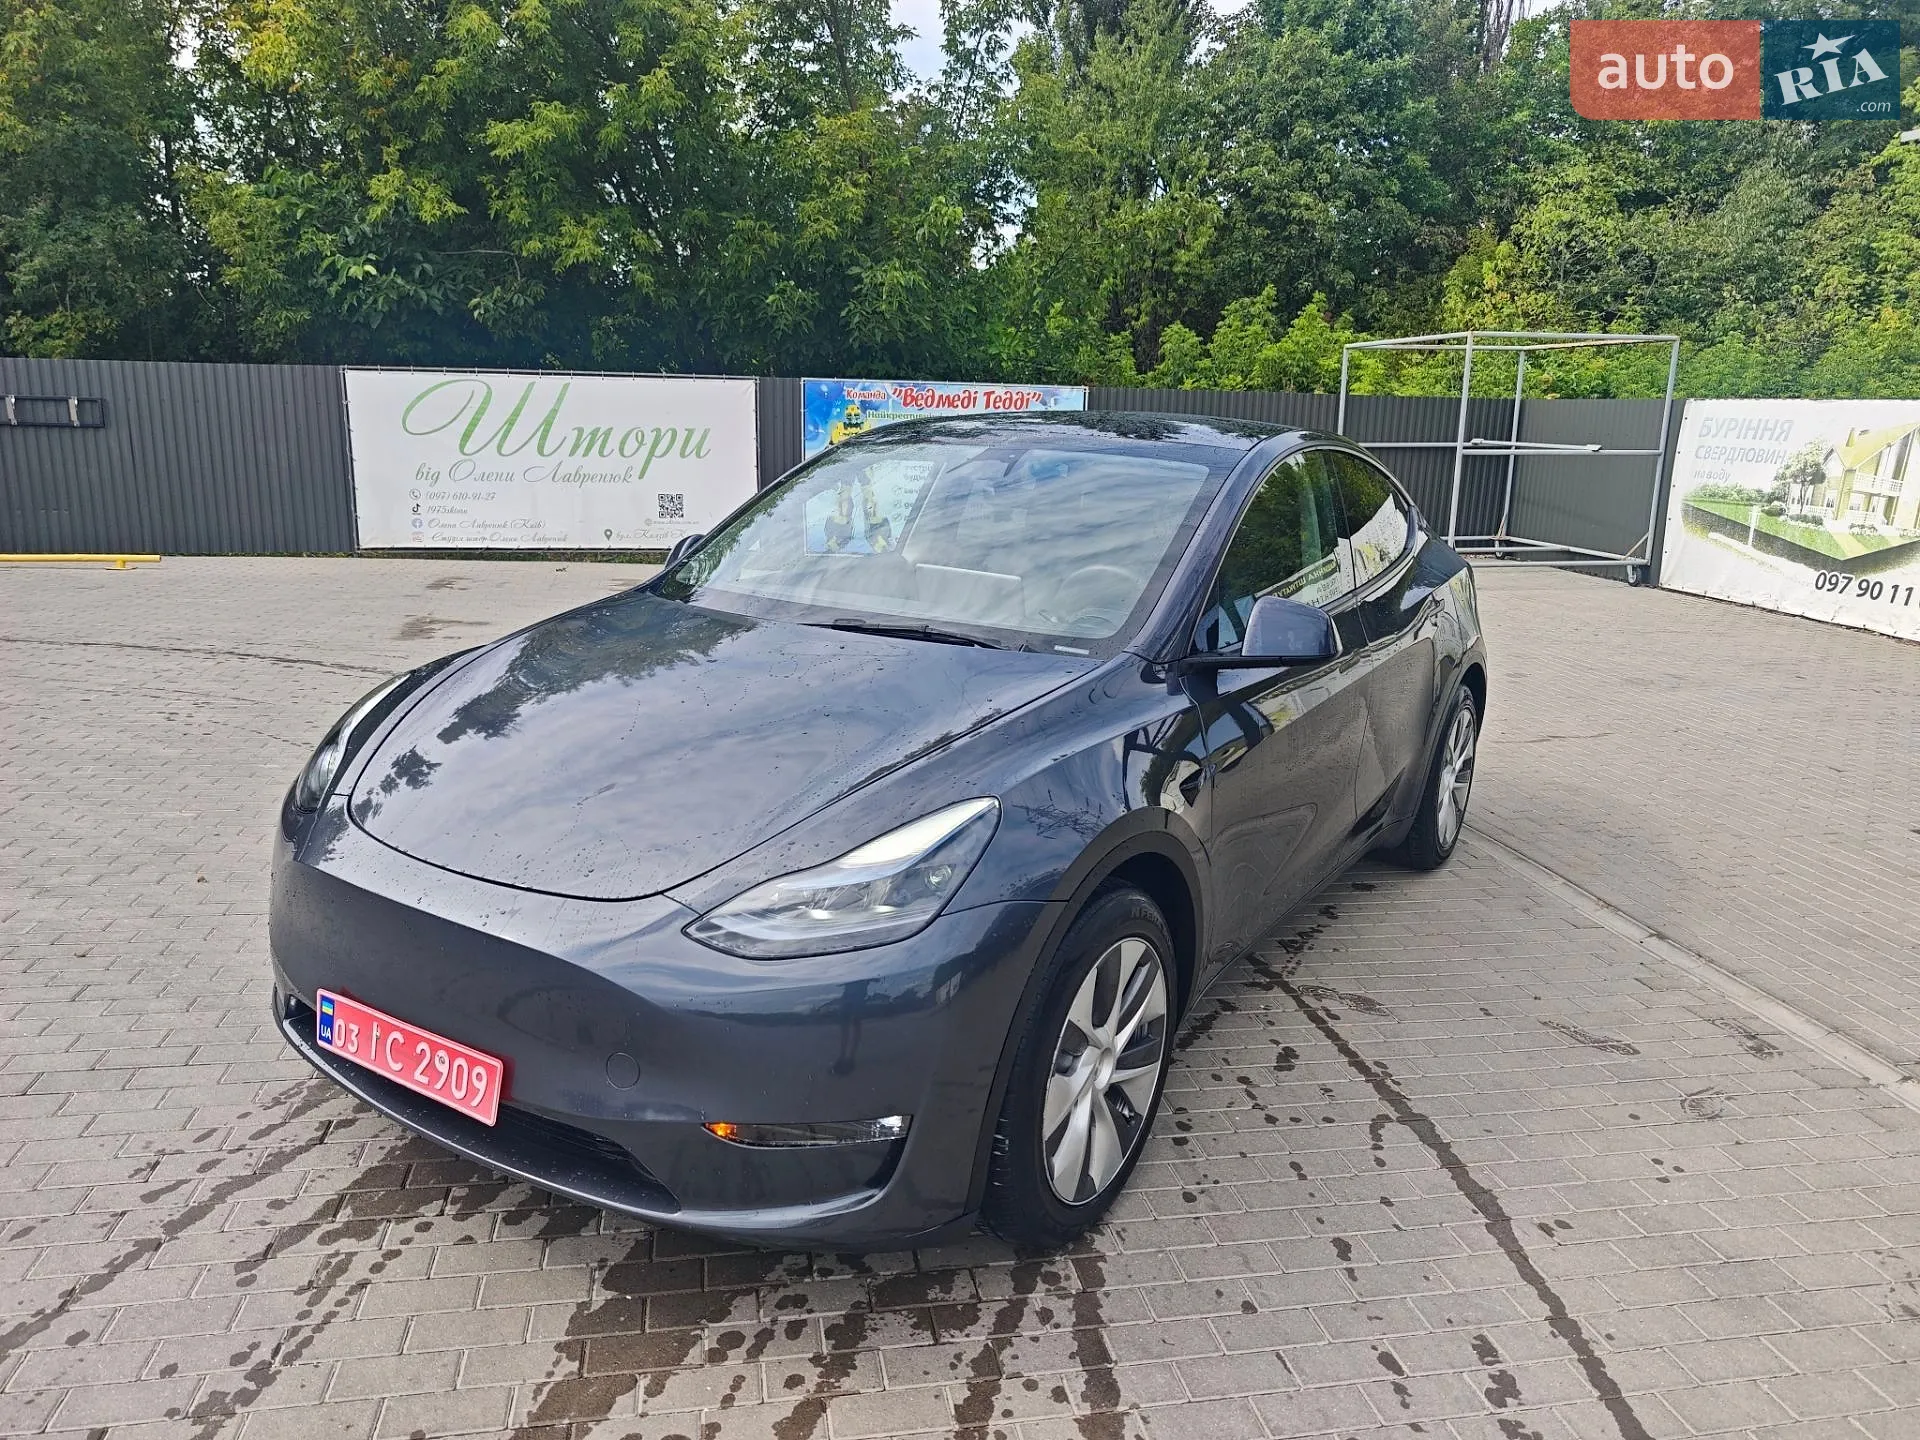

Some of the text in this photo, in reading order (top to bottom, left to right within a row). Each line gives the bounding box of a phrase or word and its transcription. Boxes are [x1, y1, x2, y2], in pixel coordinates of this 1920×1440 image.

[846, 389, 886, 400] Команда
[402, 379, 711, 479] Штори
[1698, 416, 1794, 441] БУРІННЯ
[1695, 444, 1787, 465] СВЕРДЛОВИН
[415, 458, 633, 488] від Олени Лавренюк
[1815, 572, 1914, 606] 097 90 11
[320, 1024, 332, 1041] UA
[335, 1018, 360, 1053] 03
[413, 1041, 488, 1107] 2909
